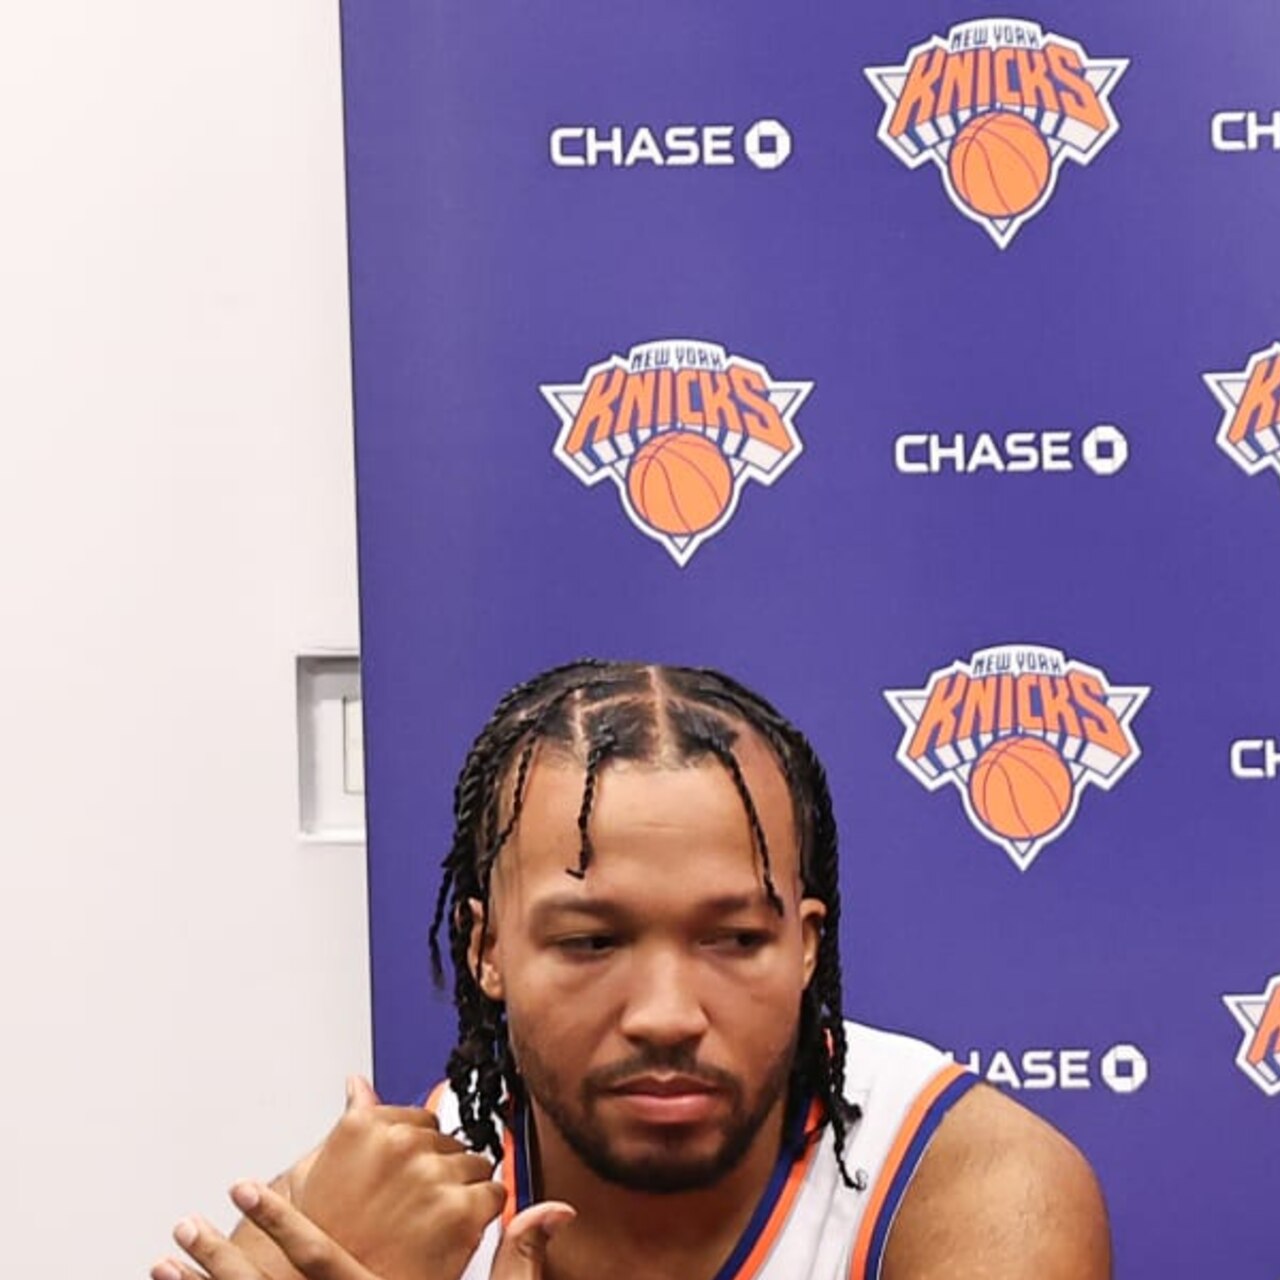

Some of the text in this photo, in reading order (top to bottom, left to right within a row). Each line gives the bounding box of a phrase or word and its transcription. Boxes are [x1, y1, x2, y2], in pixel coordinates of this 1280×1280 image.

[950, 23, 1040, 51] NEW YORK
[888, 43, 1110, 138] KNICKS
[549, 125, 735, 168] CHASE
[630, 345, 723, 371] NEW YORK
[564, 366, 794, 455] KNICKS
[895, 430, 1074, 474] CHASE
[972, 650, 1063, 675] NEW YORK
[907, 670, 1132, 761] KNICKS
[965, 1050, 1092, 1089] ASE
